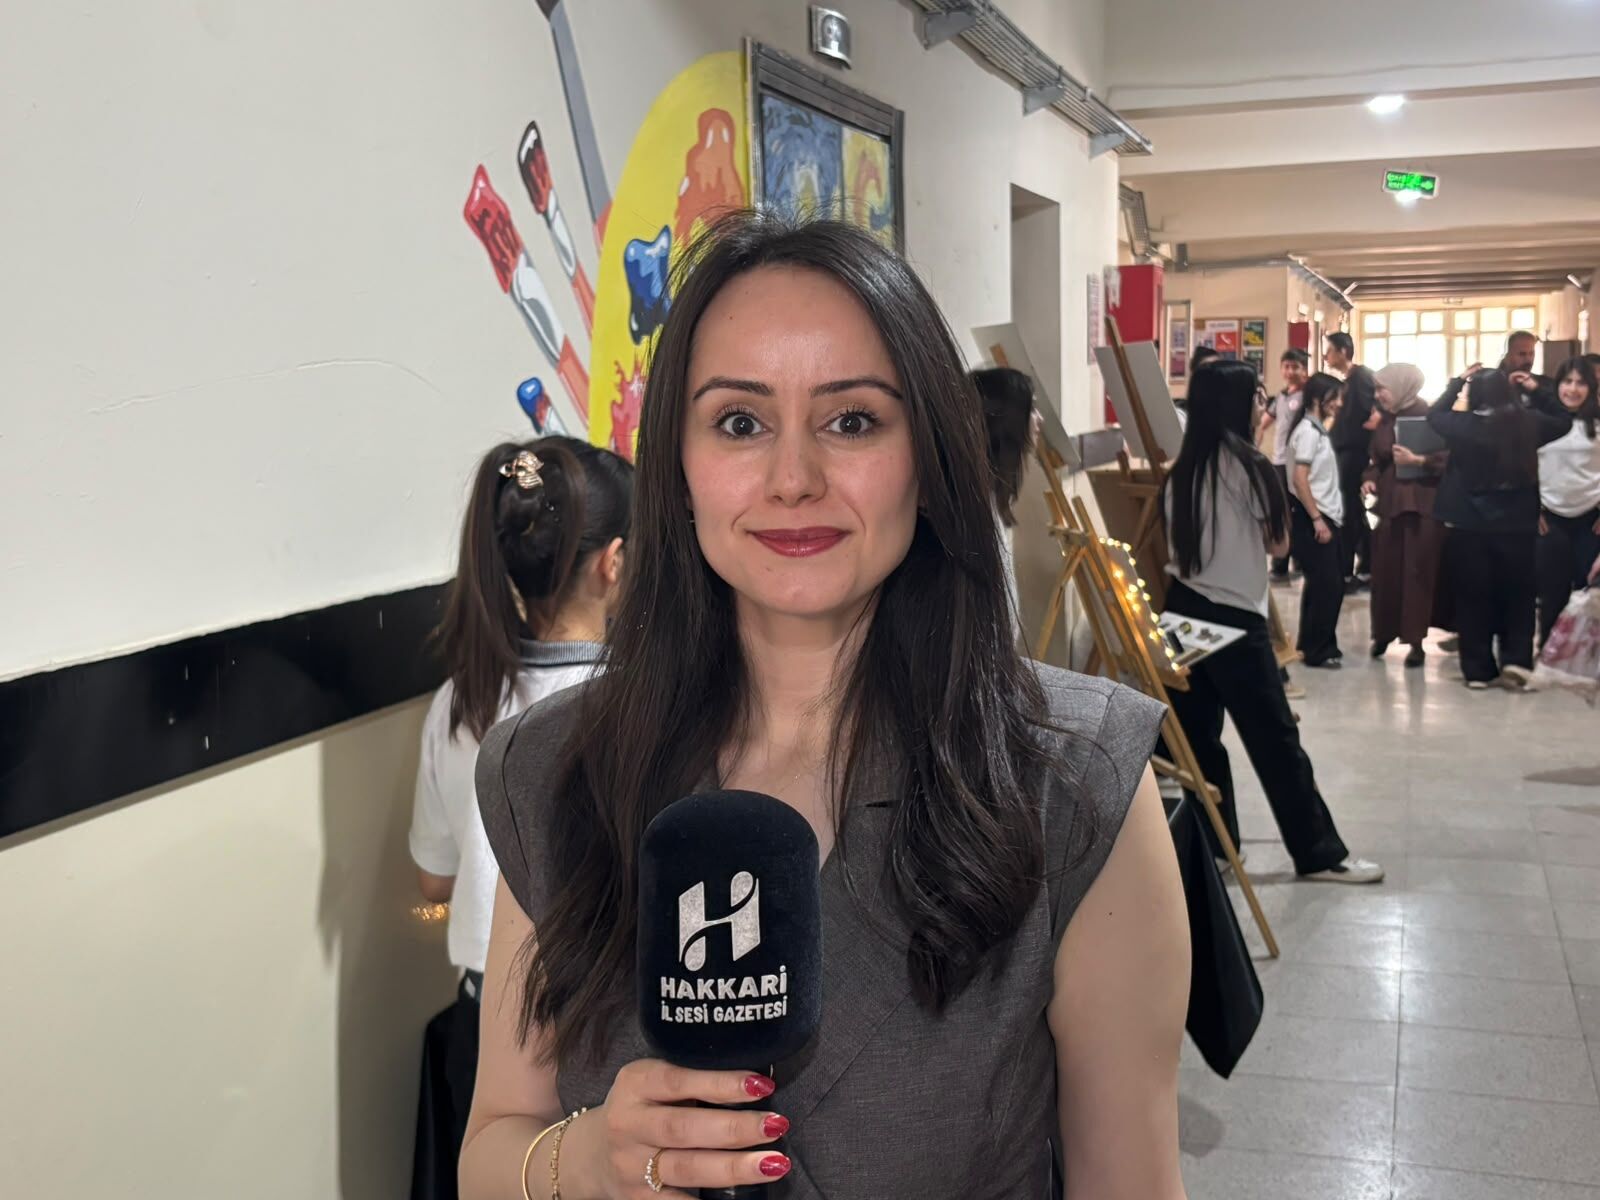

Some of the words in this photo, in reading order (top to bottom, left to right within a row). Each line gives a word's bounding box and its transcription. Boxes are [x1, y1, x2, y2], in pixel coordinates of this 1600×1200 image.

[678, 871, 761, 972] H
[660, 965, 788, 1000] HAKKARİ
[661, 1000, 674, 1022] İL
[675, 1003, 709, 1024] SESİ
[713, 995, 788, 1023] GAZETESİ
